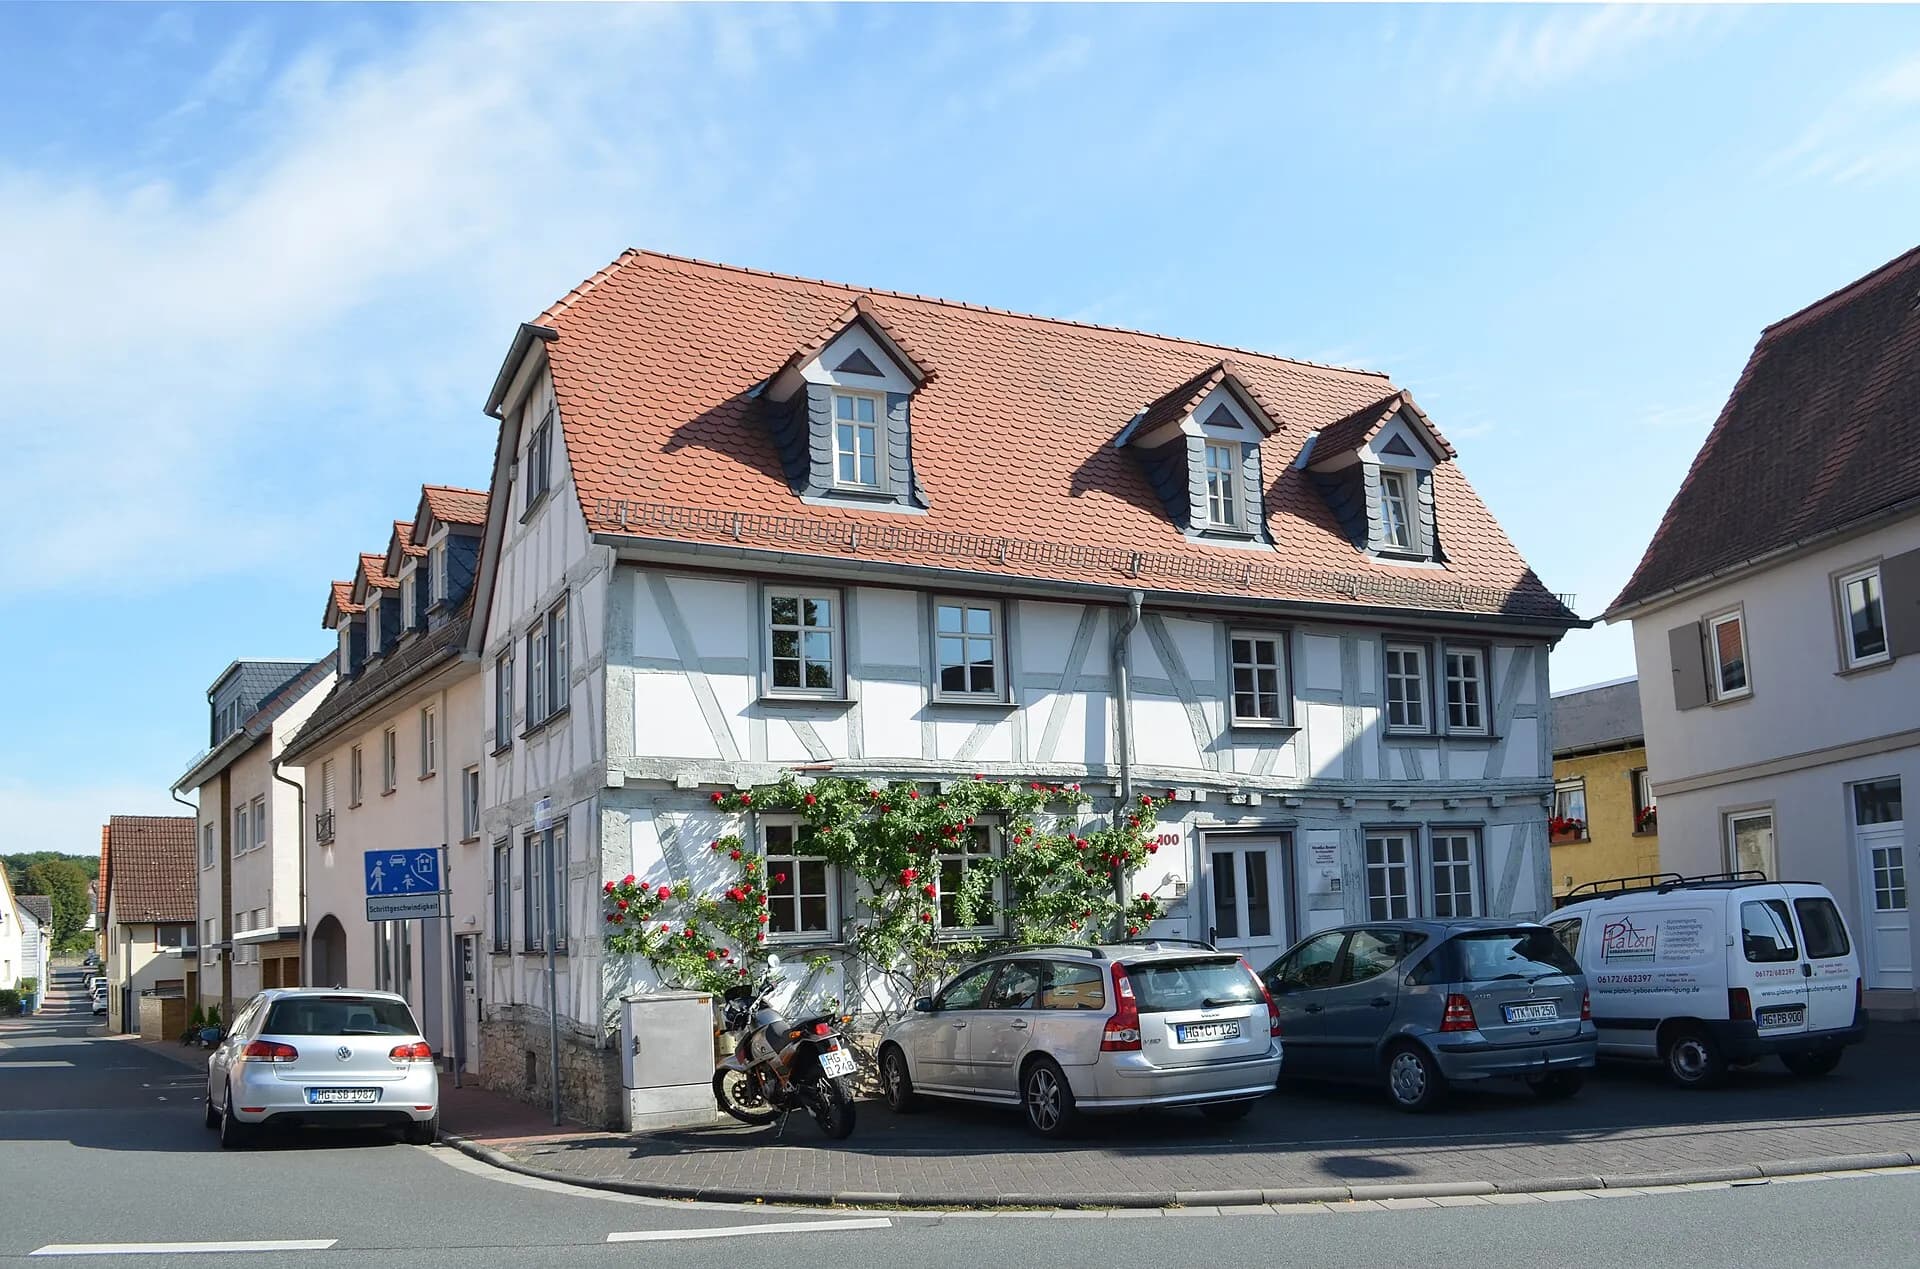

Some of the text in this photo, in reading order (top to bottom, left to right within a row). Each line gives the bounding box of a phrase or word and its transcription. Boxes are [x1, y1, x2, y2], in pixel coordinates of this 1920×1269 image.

[369, 903, 438, 913] Schrittgeschwindigkeit
[1755, 968, 1795, 978] 06172/682397
[1597, 974, 1652, 984] 06172/682397
[1512, 1005, 1555, 1019] MTK VH 250
[1763, 1012, 1802, 1025] HG PB 900
[1184, 1023, 1238, 1038] HG CT 125
[826, 1053, 840, 1064] HG
[318, 1090, 374, 1100] HG SB 1987
